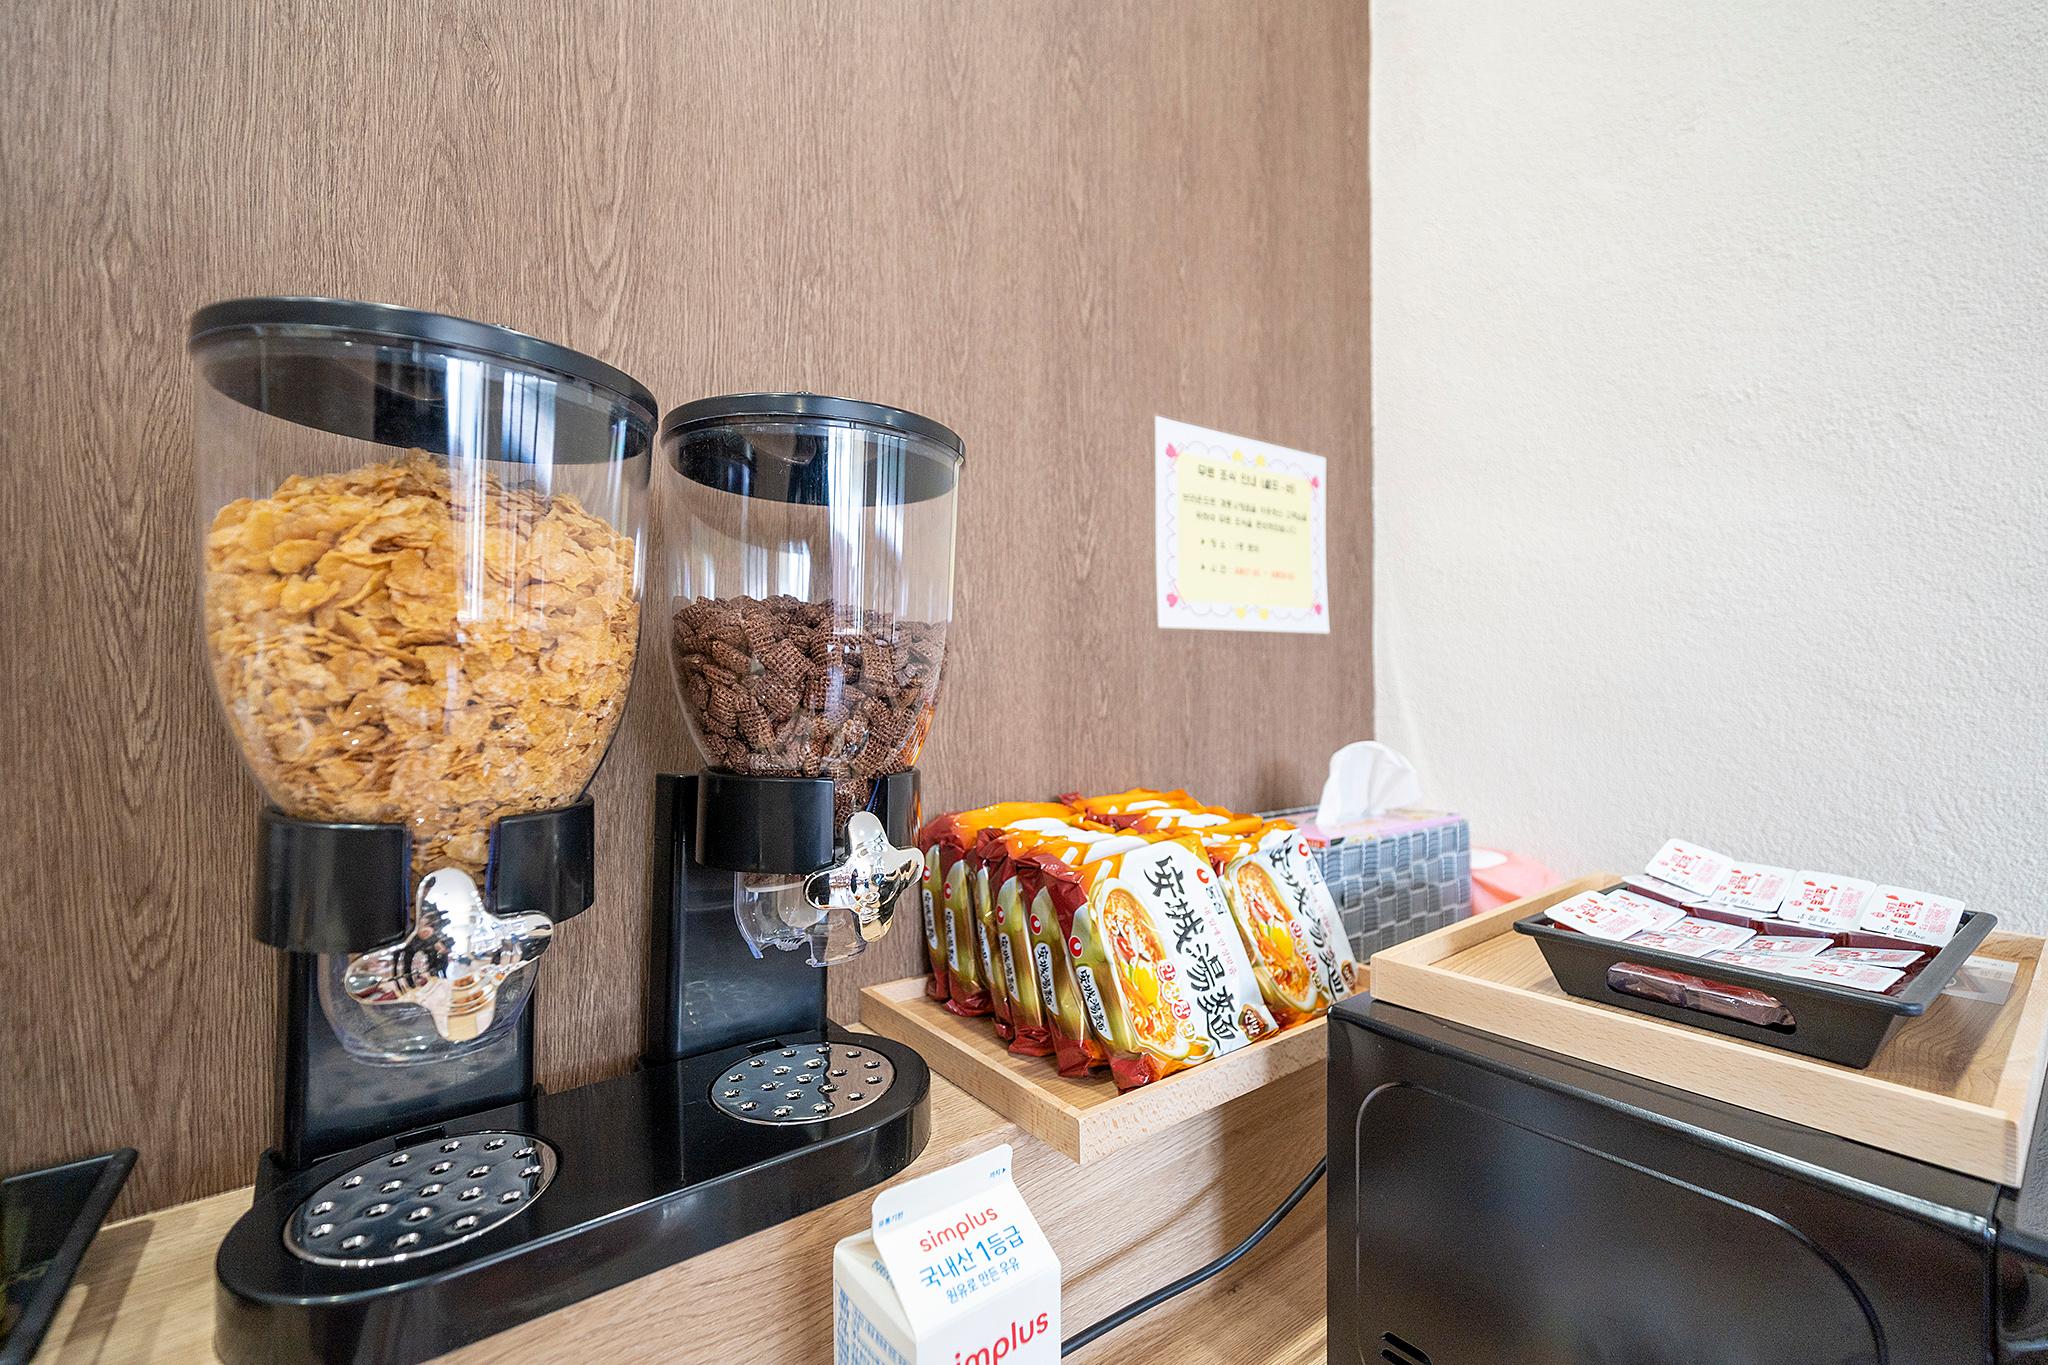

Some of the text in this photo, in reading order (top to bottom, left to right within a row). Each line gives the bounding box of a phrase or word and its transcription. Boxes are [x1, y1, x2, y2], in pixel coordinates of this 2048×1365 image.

[1144, 855, 1239, 1050] 安城湯麵
[920, 1208, 998, 1252] simplus
[946, 1256, 1020, 1304] 원유로 만든 우유
